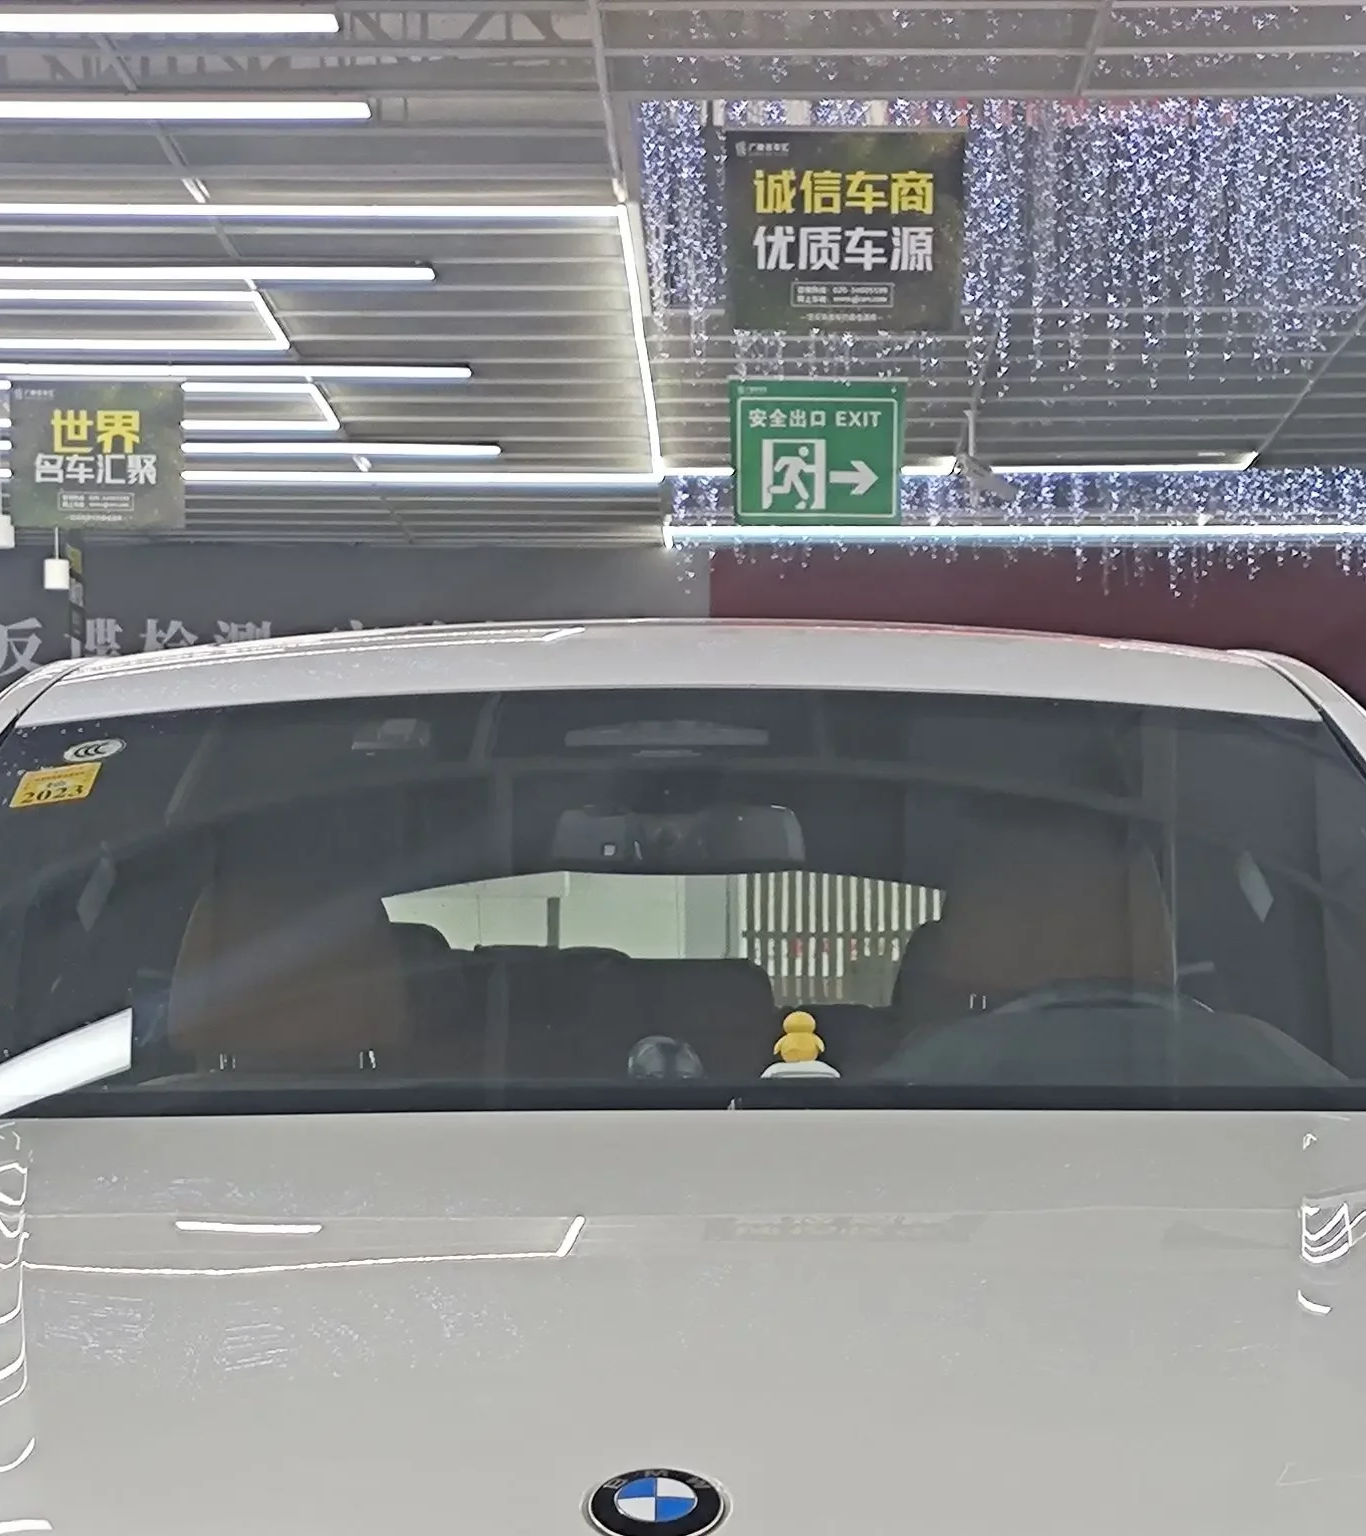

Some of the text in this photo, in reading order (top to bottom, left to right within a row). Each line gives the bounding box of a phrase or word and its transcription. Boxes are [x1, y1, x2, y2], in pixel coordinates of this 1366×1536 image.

[753, 169, 934, 215] 诚信车商
[752, 225, 935, 272] 优质车源
[50, 407, 141, 455] 世界
[748, 408, 883, 429] 安全出口 EXIT
[34, 452, 158, 486] 名车汇聚
[19, 784, 85, 805] 2023
[602, 1468, 712, 1490] BMW
